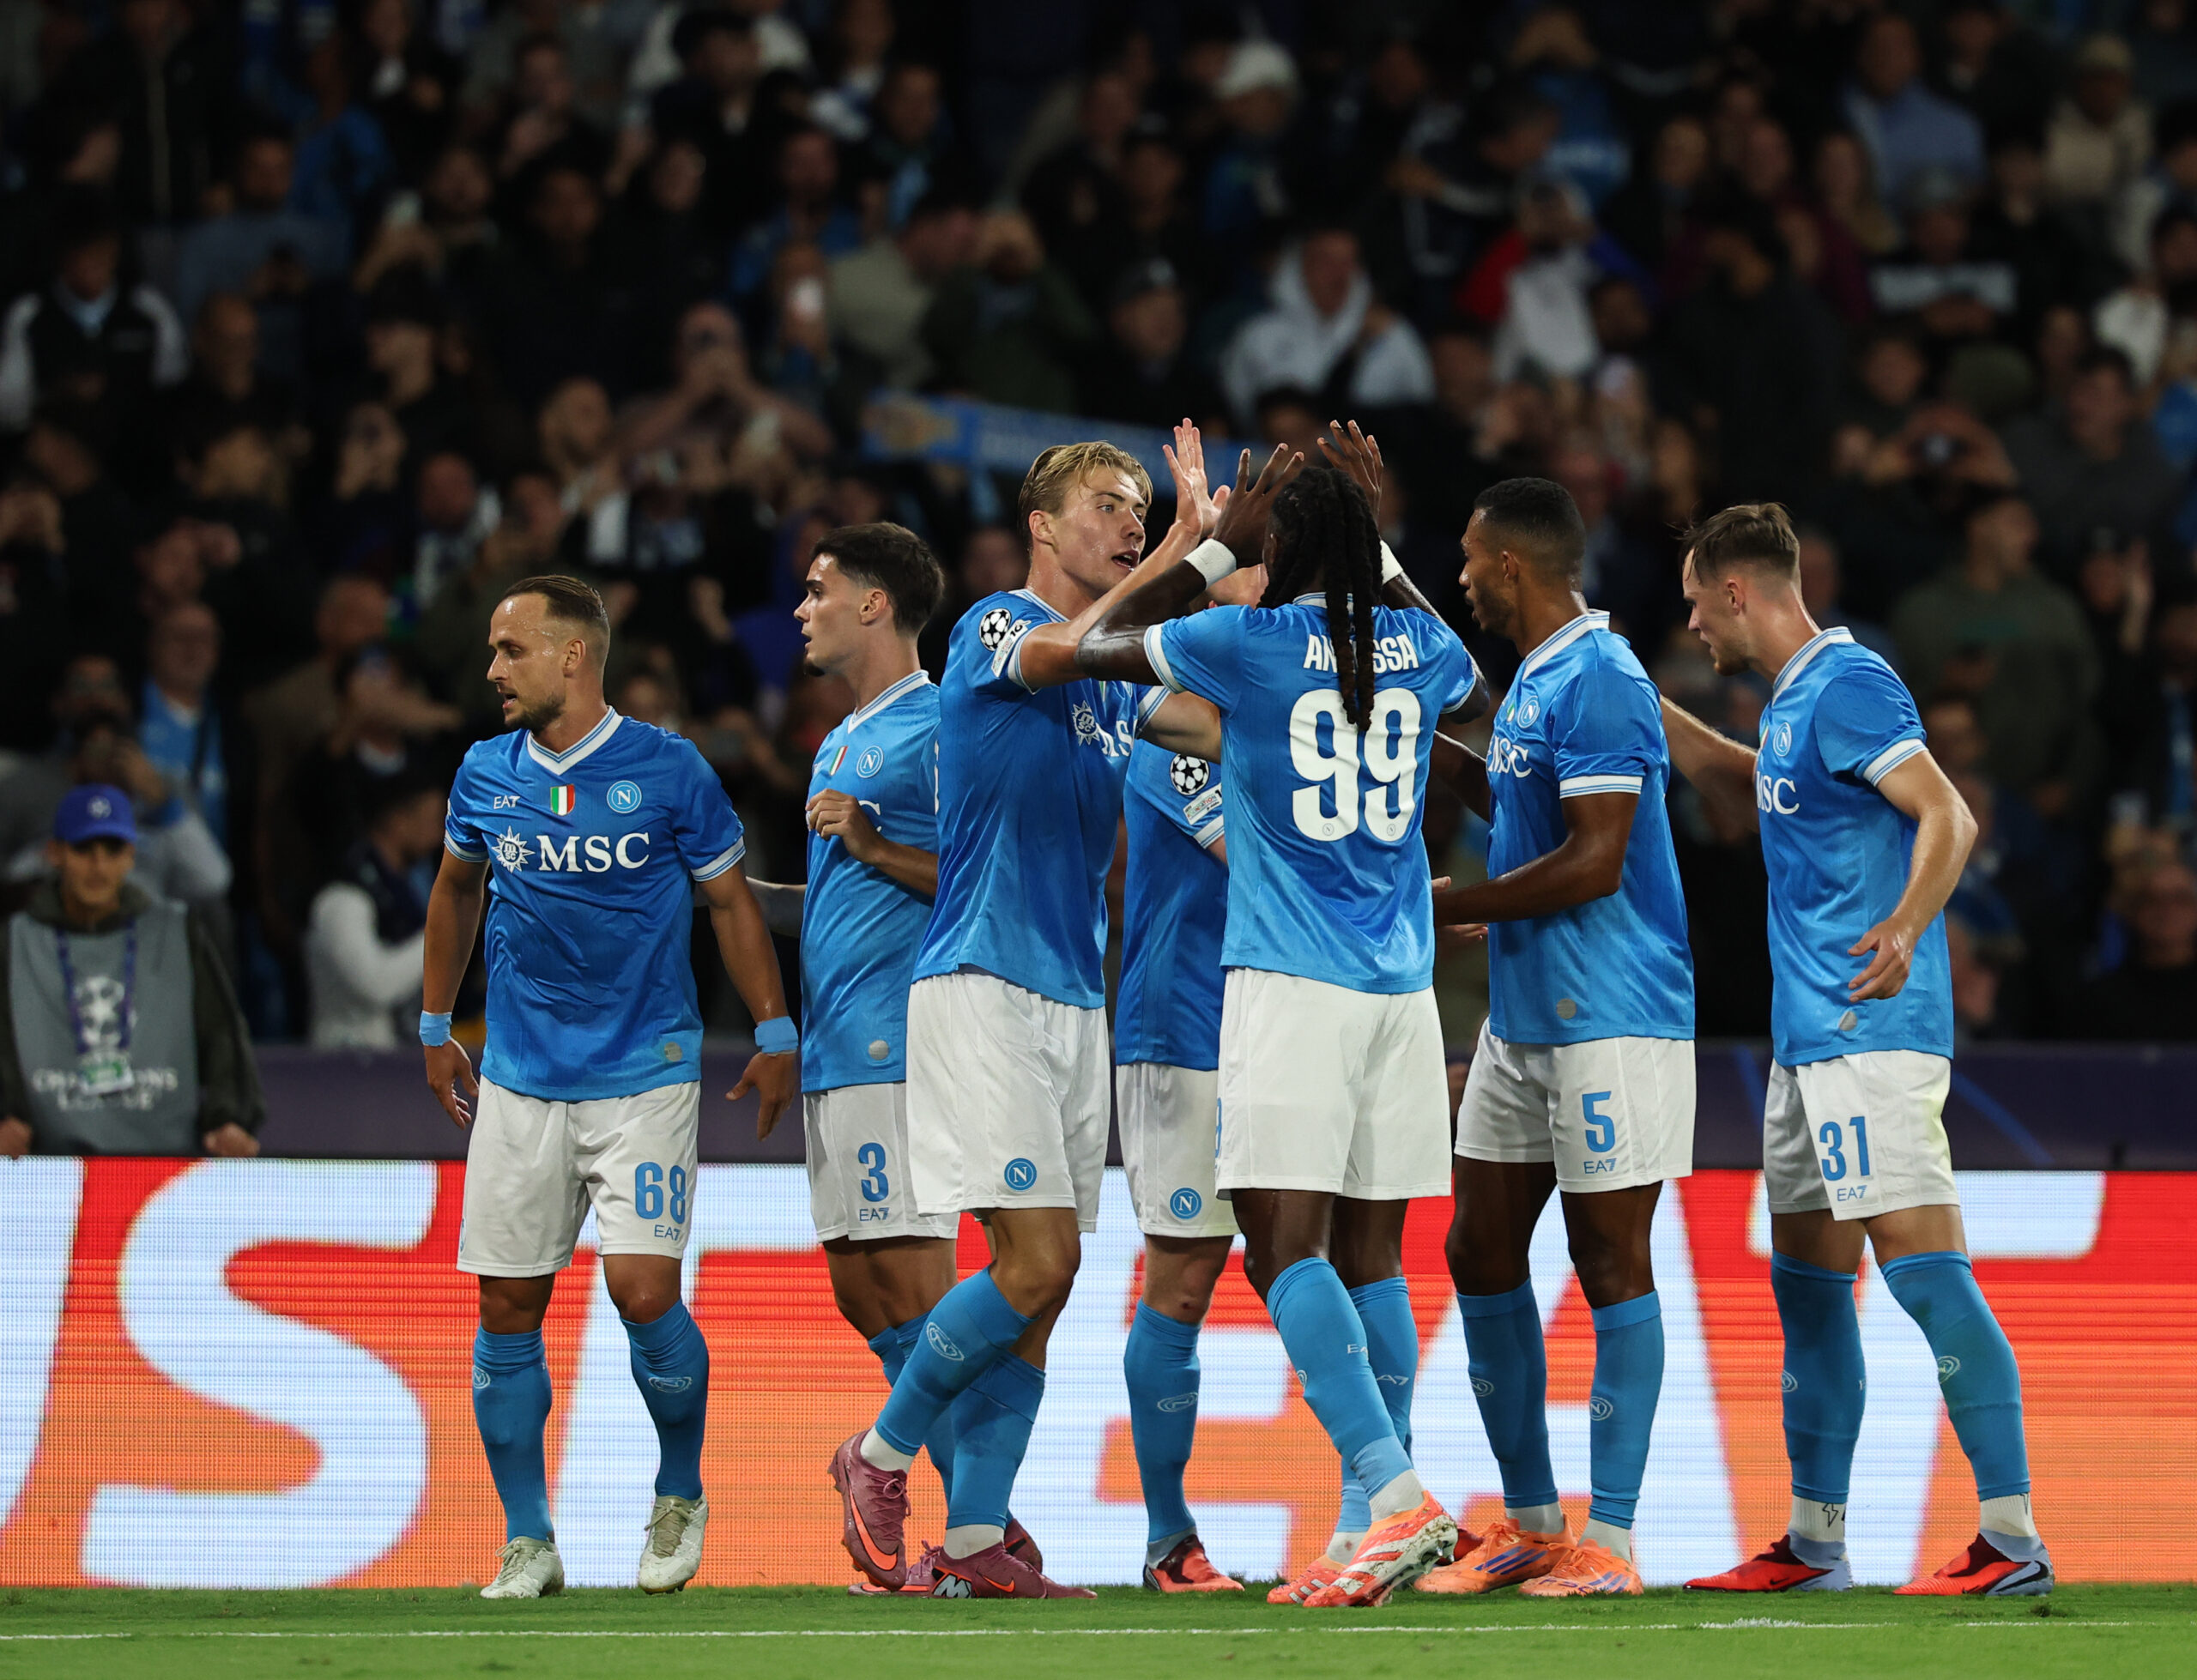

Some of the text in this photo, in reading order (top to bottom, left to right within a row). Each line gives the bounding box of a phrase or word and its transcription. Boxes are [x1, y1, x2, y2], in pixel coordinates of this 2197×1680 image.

[1303, 633, 1419, 674] ANSSA
[1289, 687, 1421, 842] 99
[536, 831, 650, 873] MSC
[1582, 1091, 1615, 1152] 5
[1583, 1158, 1617, 1174] EA7
[1819, 1115, 1870, 1181] 31
[635, 1161, 686, 1224] 68
[858, 1142, 889, 1202] 3
[1837, 1185, 1867, 1201] EA7
[654, 1224, 681, 1241] EA7
[859, 1207, 889, 1221] EA7
[0, 1158, 839, 1586] ST
[1347, 1344, 1369, 1361] EA
[1376, 1374, 1409, 1387] A7
